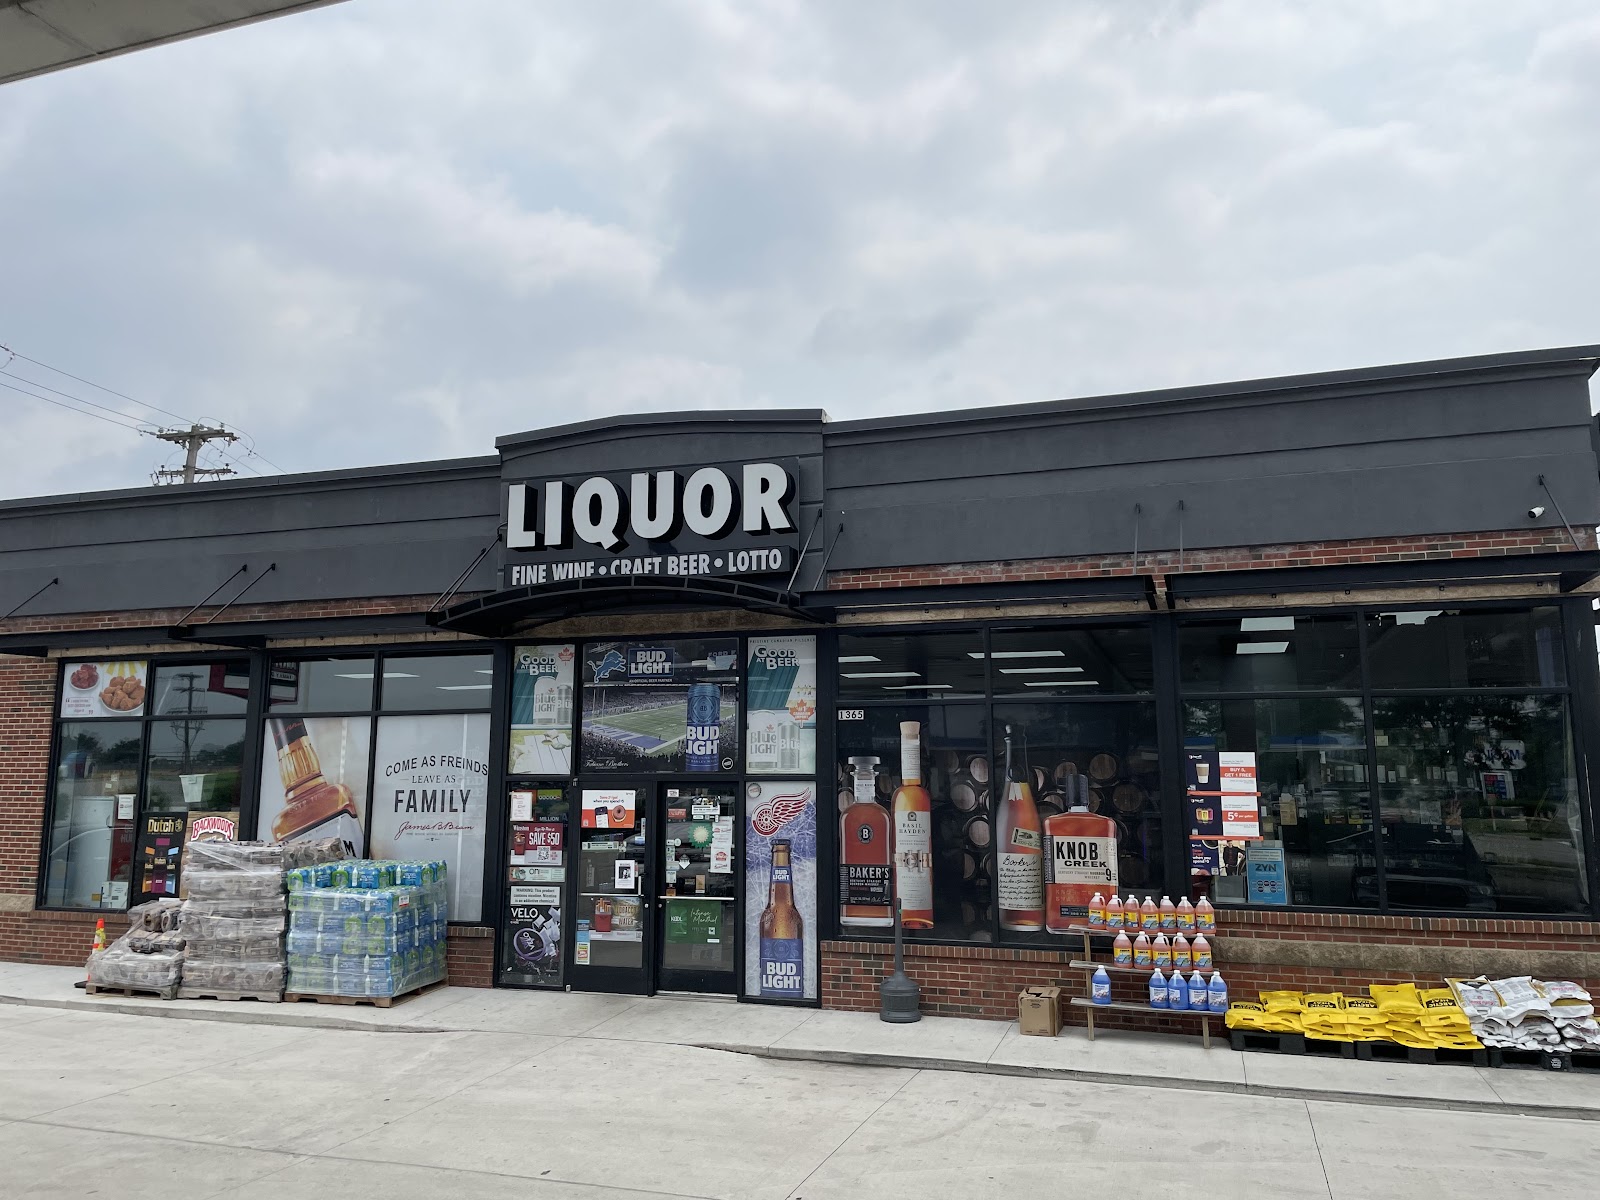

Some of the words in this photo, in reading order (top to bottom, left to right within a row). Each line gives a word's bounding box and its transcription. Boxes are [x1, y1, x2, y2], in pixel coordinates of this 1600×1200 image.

[507, 463, 791, 549] LIQUOR
[512, 565, 546, 586] FINE
[552, 562, 594, 581] WINE
[611, 557, 662, 575] CRAFT
[668, 554, 710, 576] BEER
[728, 549, 782, 572] LOTTO
[520, 654, 557, 665] GOOD
[637, 652, 666, 663] BUD
[755, 646, 797, 660] GOOD
[530, 664, 559, 676] BEER
[630, 662, 672, 674] LIGHT
[766, 658, 800, 670] BEER
[536, 693, 556, 704] Blue
[535, 704, 556, 712] LIGHT
[840, 711, 862, 720] 1365
[687, 726, 720, 740] BUD
[750, 731, 776, 744] Blue
[750, 744, 776, 754] LIGHT
[386, 758, 418, 776] COME
[421, 756, 436, 768] AS
[440, 756, 488, 776] FREINDS
[412, 775, 442, 784] LEAVE
[444, 774, 456, 784] AS
[394, 790, 471, 812] FAMILY
[148, 818, 175, 832] Dutch
[192, 817, 234, 840] BACKWOODS
[394, 821, 431, 840] James
[529, 832, 546, 846] SAVE
[548, 832, 560, 846] $50
[863, 828, 868, 839] B
[1056, 842, 1098, 861] KNOB
[1064, 860, 1107, 868] CREEK
[1254, 864, 1277, 872] ZYN
[850, 866, 890, 879] BAKER'S
[1106, 868, 1112, 881] 9
[511, 908, 538, 918] VELO
[618, 917, 634, 926] WATER
[766, 962, 797, 976] BUD
[762, 974, 801, 988] LIGHT
